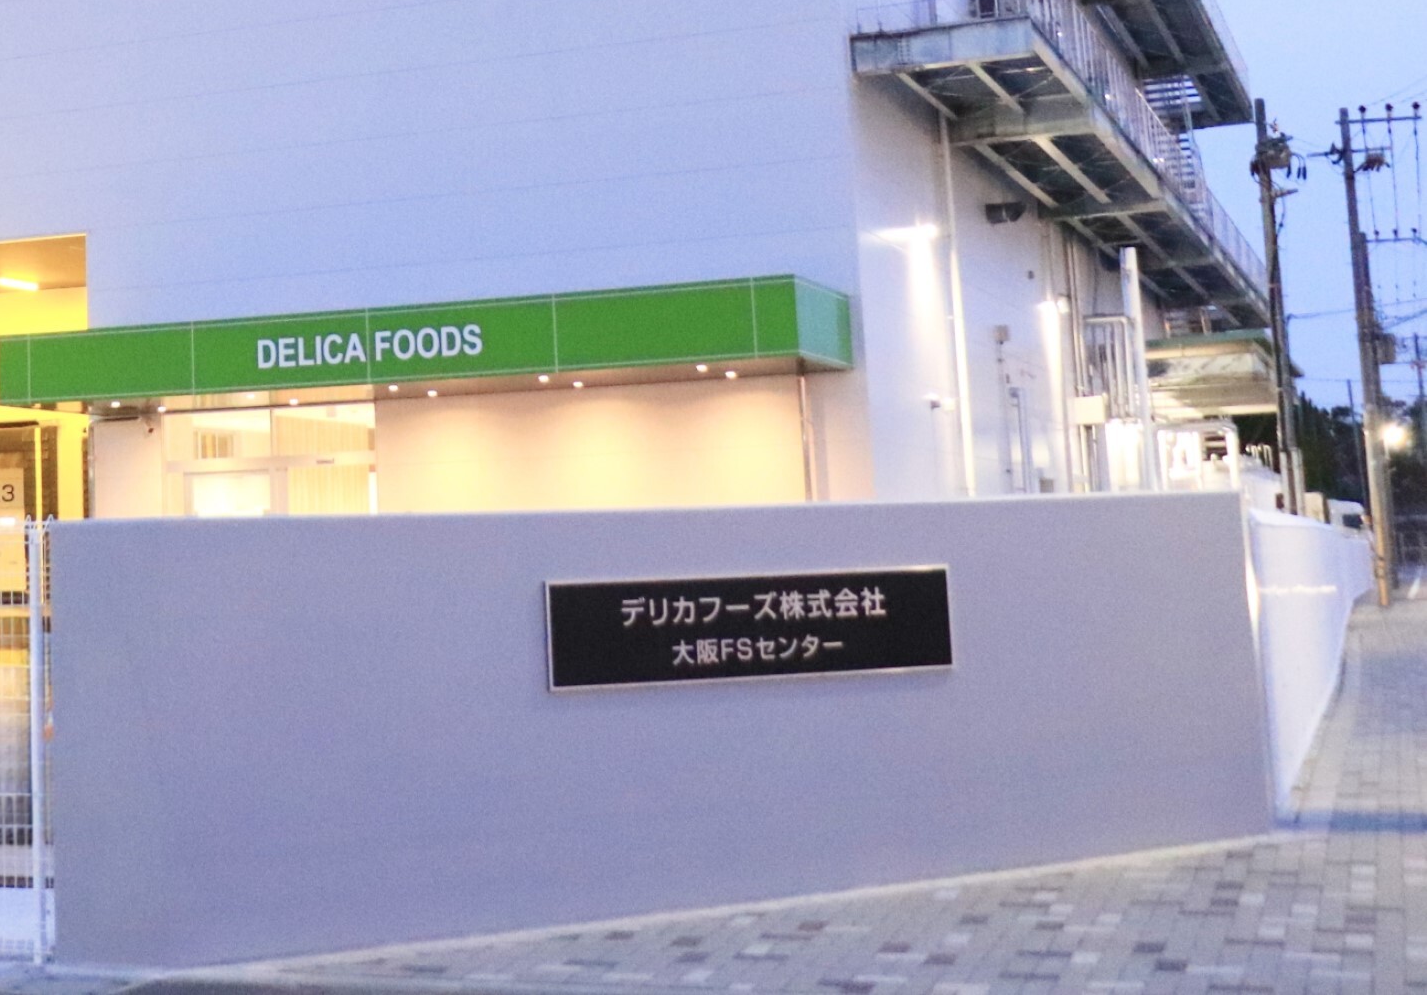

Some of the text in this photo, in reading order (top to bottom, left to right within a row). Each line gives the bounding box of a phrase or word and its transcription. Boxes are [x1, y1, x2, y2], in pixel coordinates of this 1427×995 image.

[257, 324, 483, 369] DELICA FOODS
[620, 586, 887, 628] デリカフーズ株式会社
[672, 634, 844, 666] 大阪FSセンター
